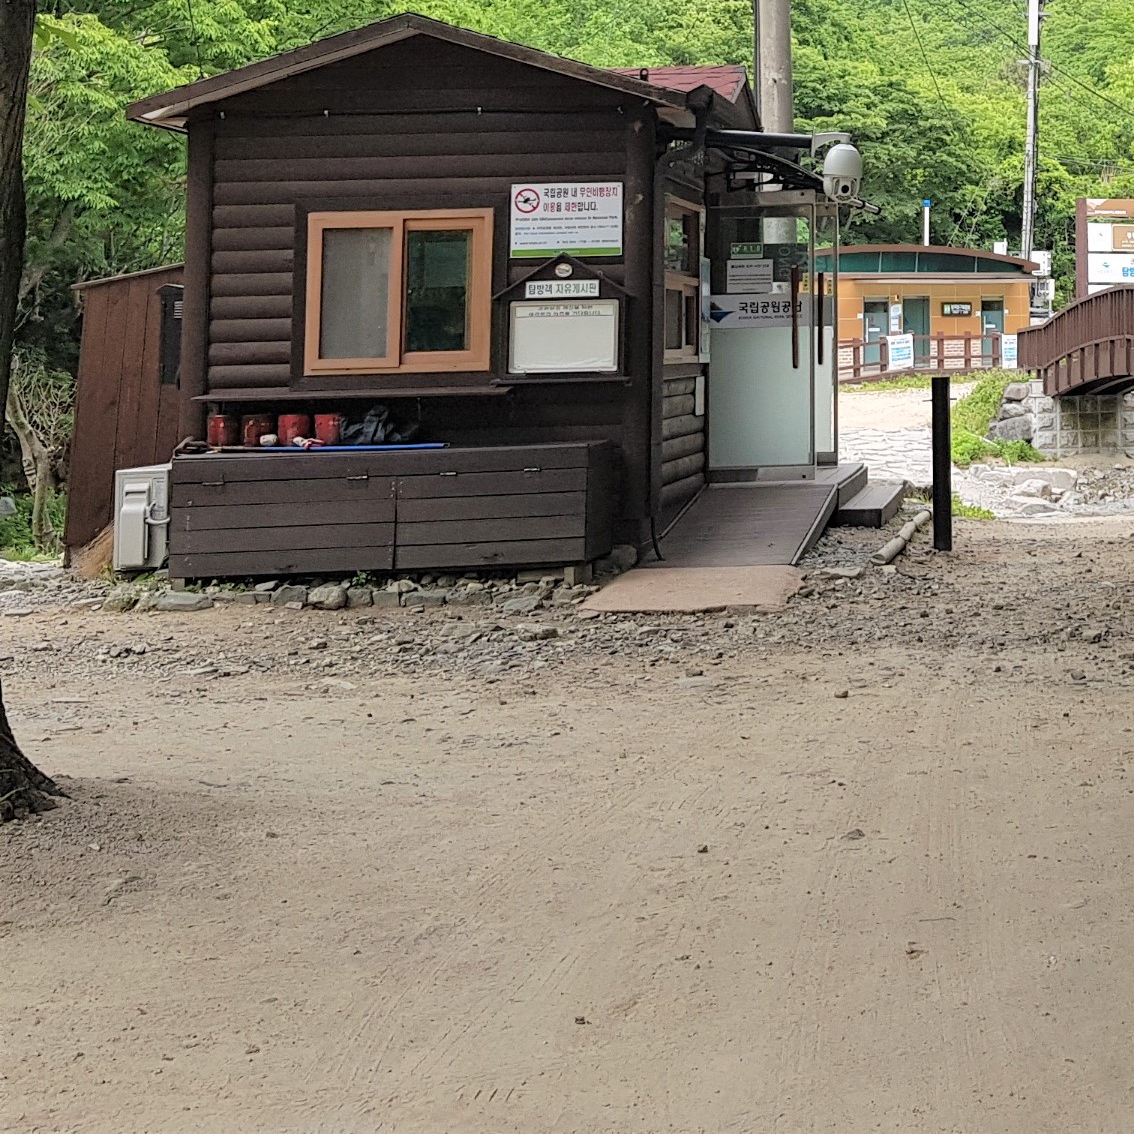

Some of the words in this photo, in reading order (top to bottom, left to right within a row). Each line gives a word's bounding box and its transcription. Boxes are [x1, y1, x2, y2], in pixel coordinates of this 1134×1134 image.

[543, 188, 569, 198] 국립공원
[570, 187, 578, 197] 내
[579, 187, 618, 197] 무인비행장치
[543, 202, 562, 212] 이용을
[528, 284, 553, 295] 탐방객
[555, 283, 597, 294] 자유게시판
